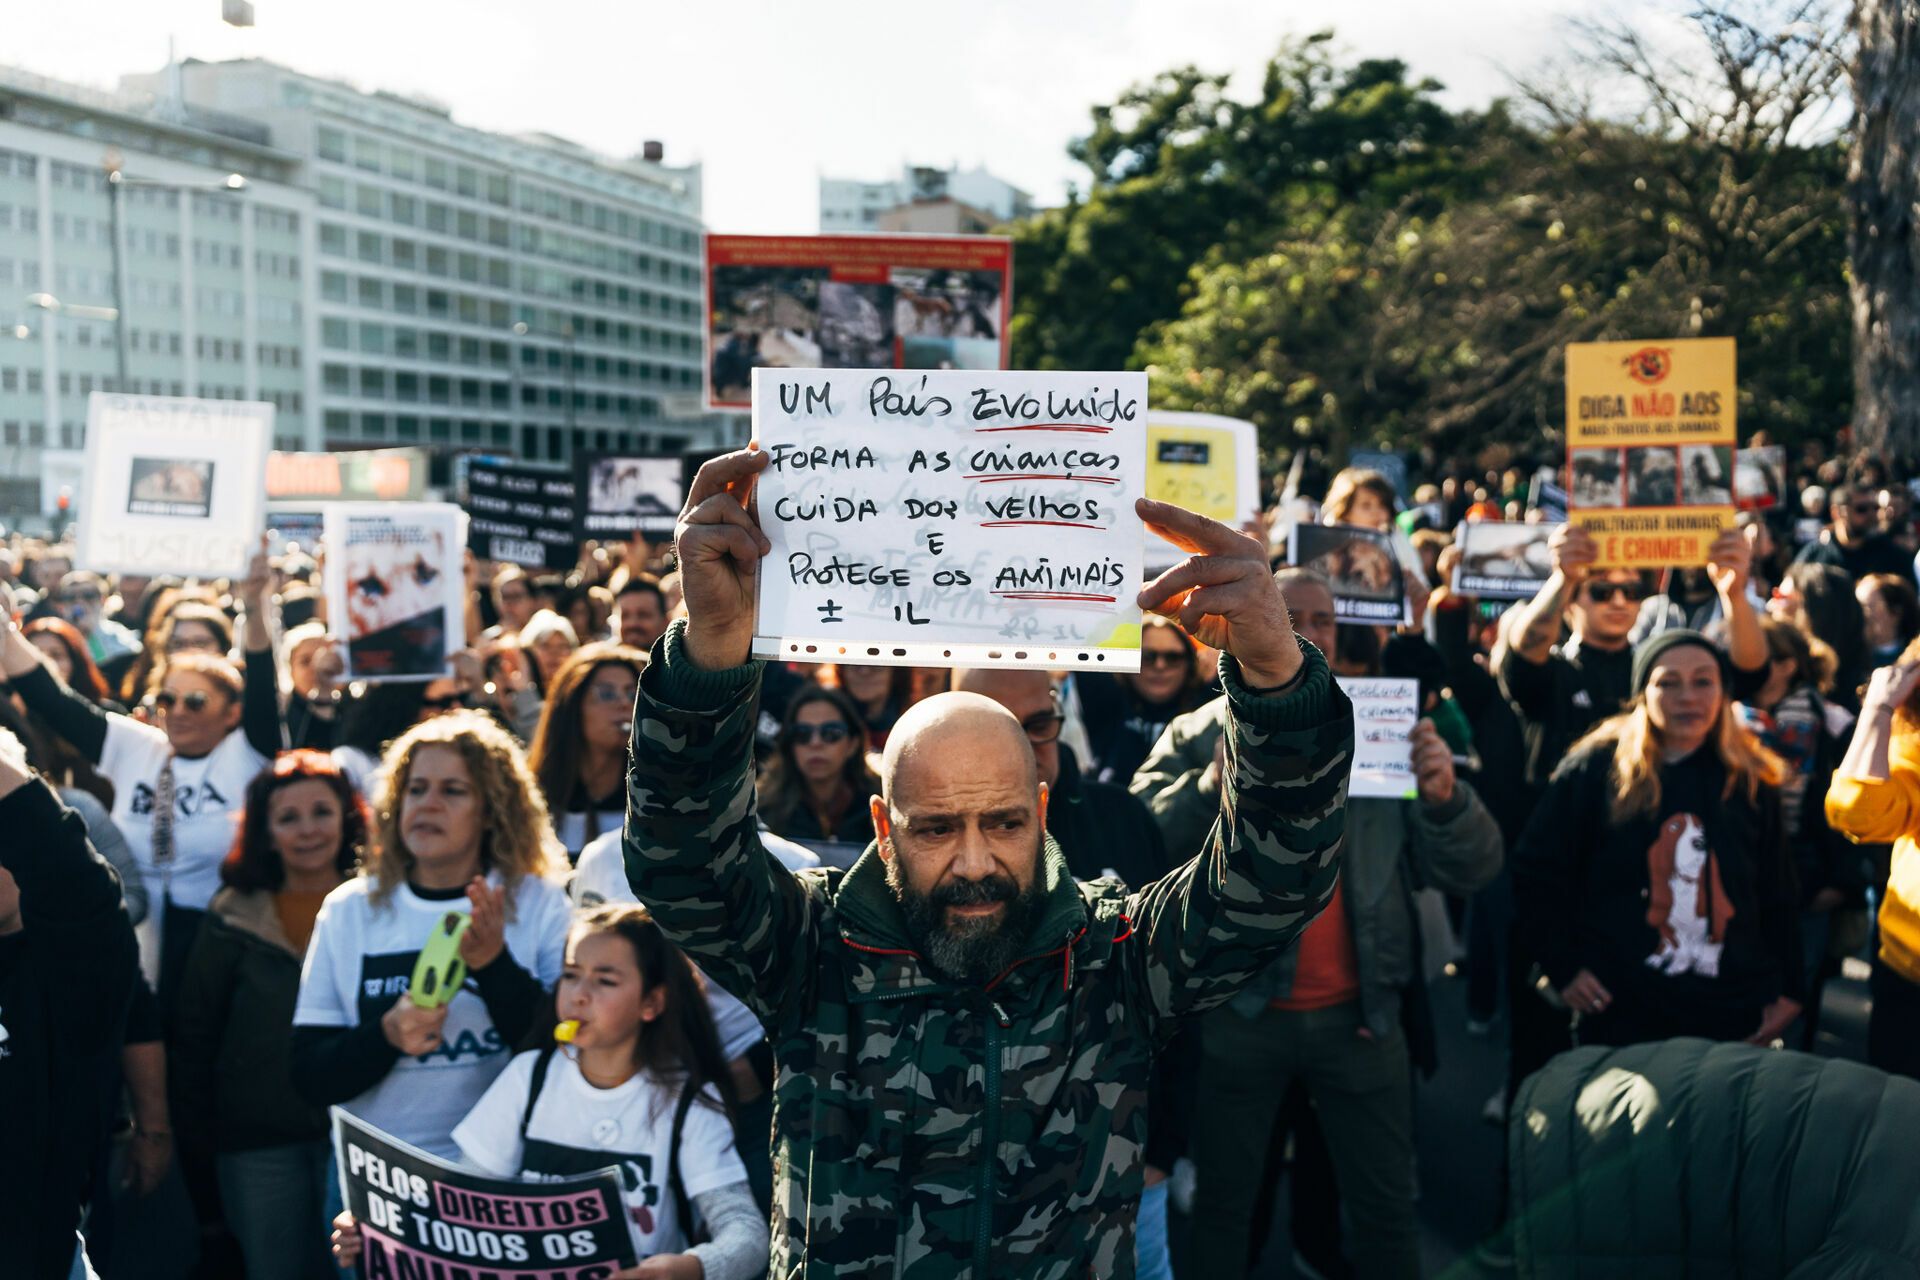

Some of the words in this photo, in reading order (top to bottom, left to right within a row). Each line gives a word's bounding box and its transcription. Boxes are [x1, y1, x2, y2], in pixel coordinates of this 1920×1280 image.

[779, 382, 833, 415] UM
[1631, 388, 1676, 418] NÃO
[1680, 391, 1721, 417] AOS
[771, 443, 876, 473] FORMA
[908, 449, 951, 473] AS
[927, 531, 944, 556] E
[348, 1143, 430, 1208] PELOS
[440, 1186, 601, 1226] DIREITOS
[367, 1191, 405, 1236] DE
[410, 1211, 529, 1262] TODOS
[542, 1230, 597, 1260] OS
